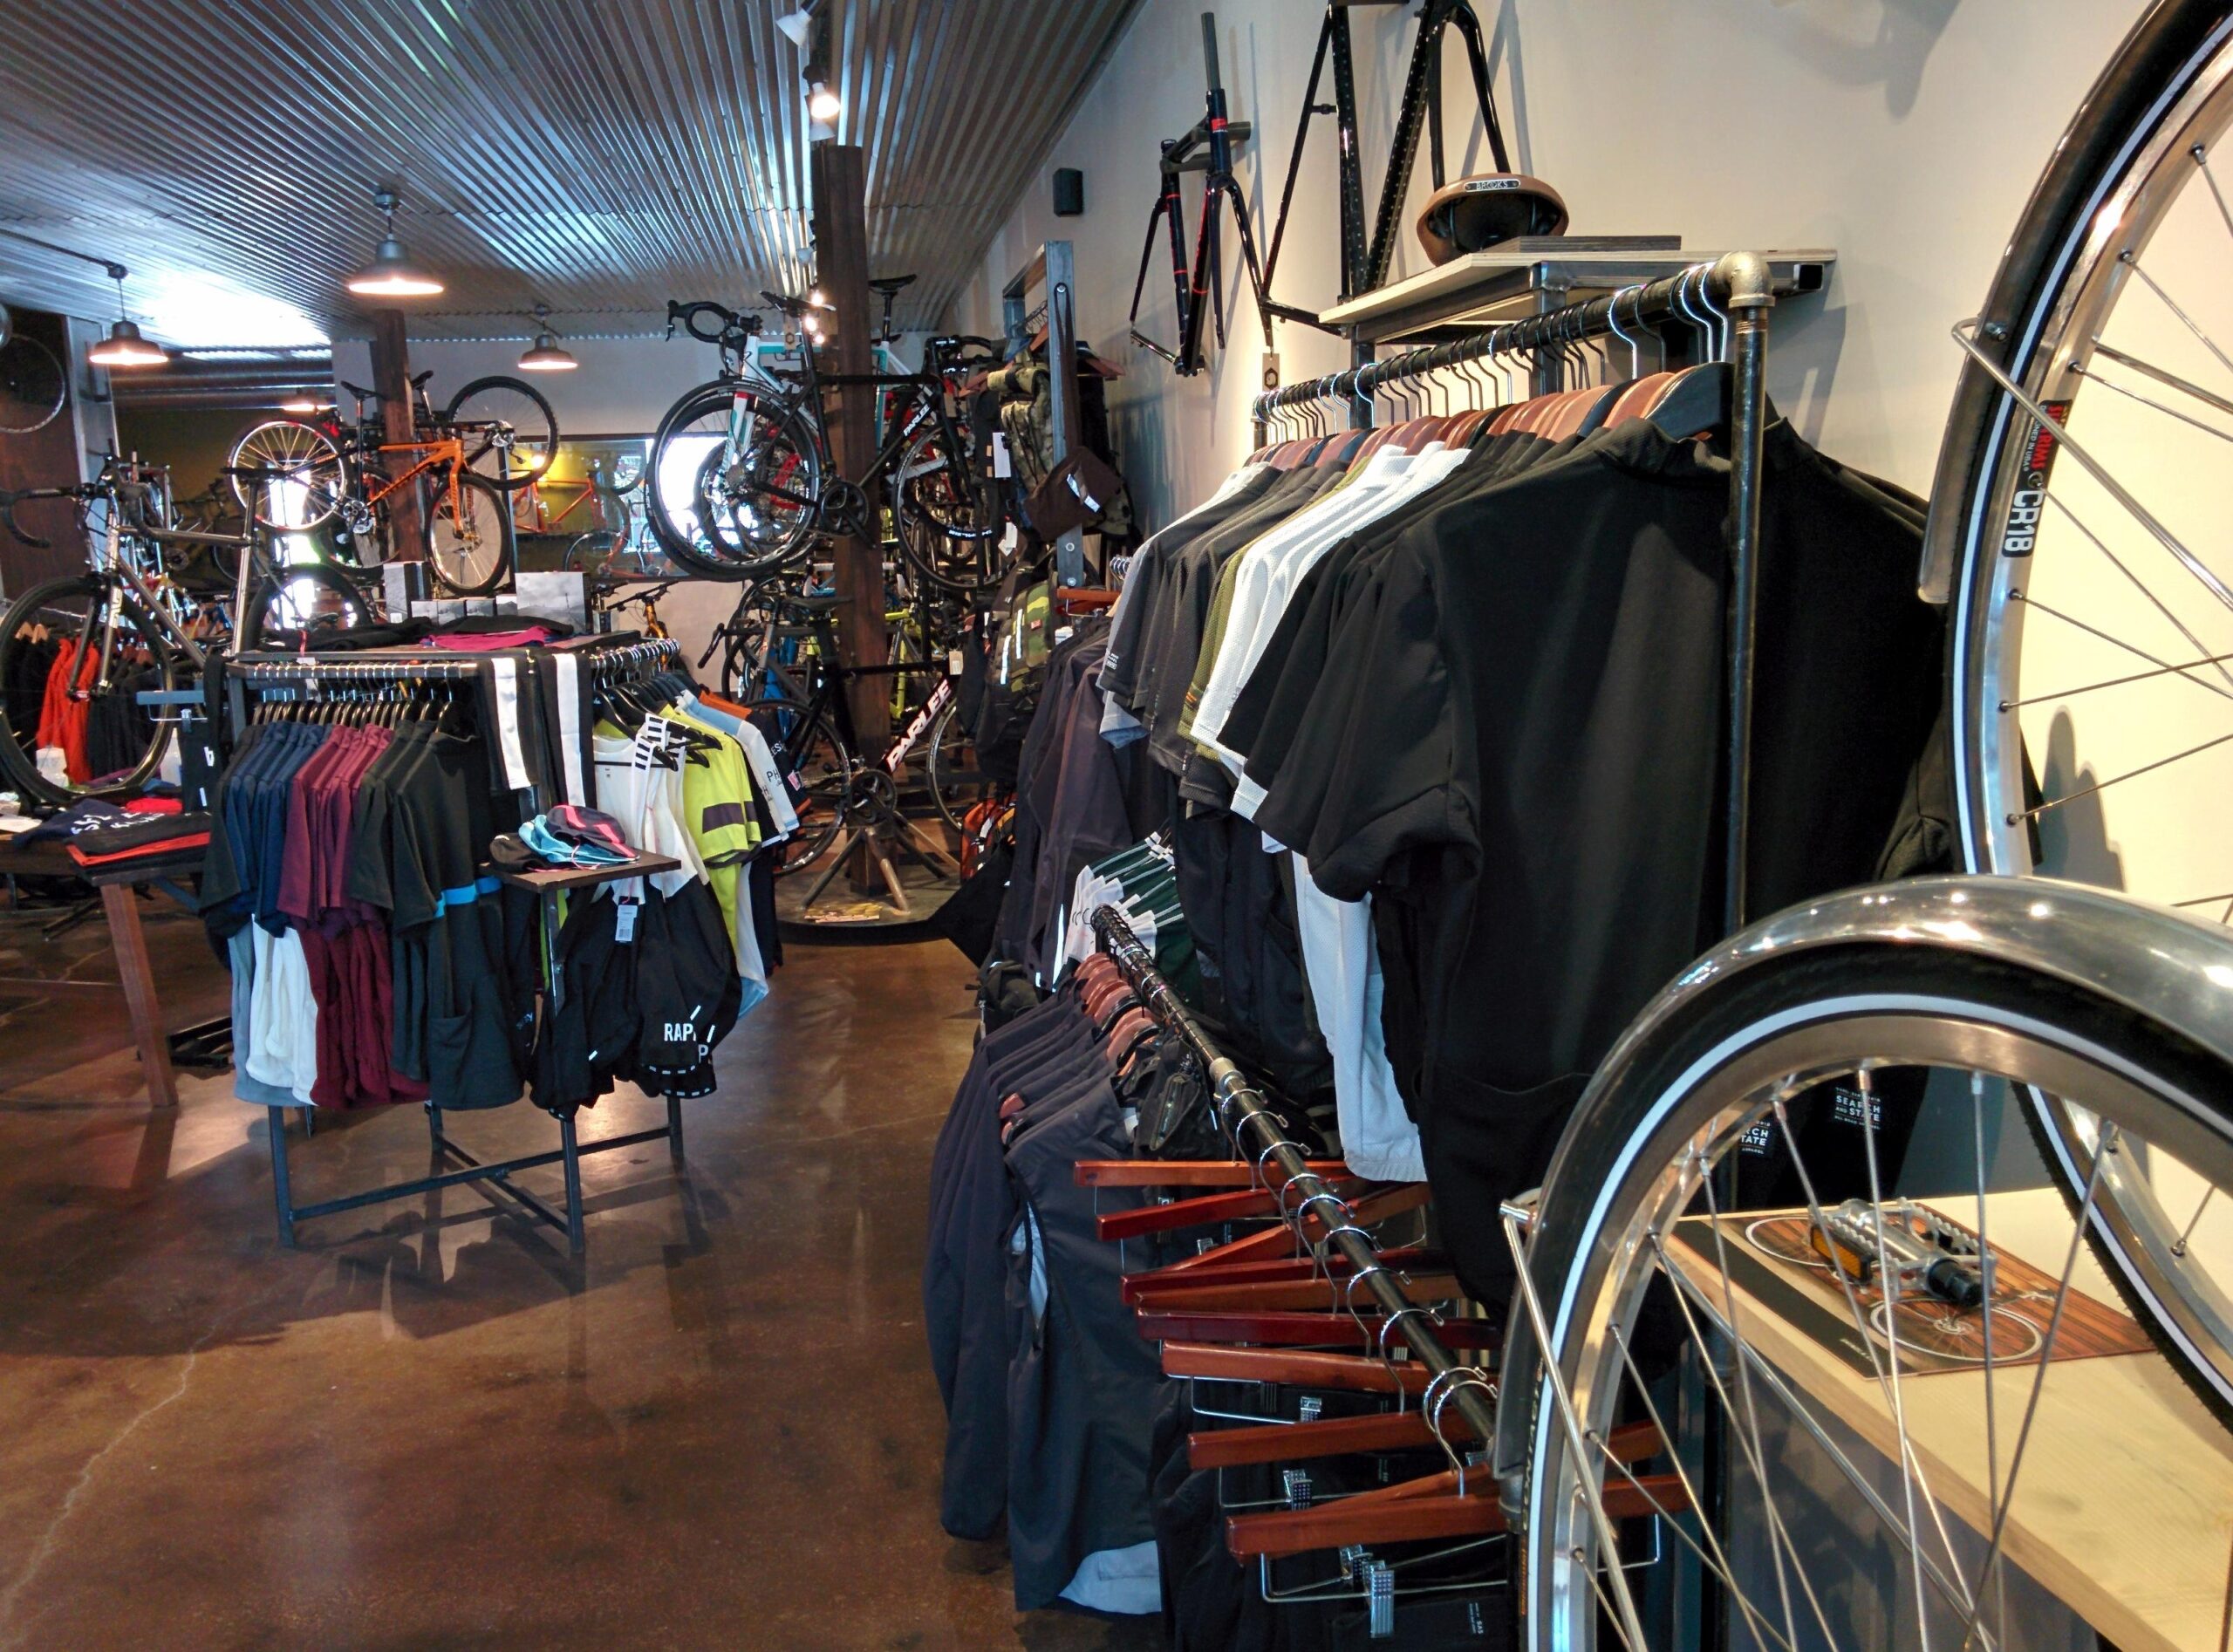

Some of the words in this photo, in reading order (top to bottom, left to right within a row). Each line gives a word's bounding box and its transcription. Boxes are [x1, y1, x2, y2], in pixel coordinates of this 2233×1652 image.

[1476, 181, 1509, 190] BROOKS
[903, 403, 931, 437] PARLEE
[2004, 490, 2044, 552] CR18
[886, 679, 952, 773] PARLEE
